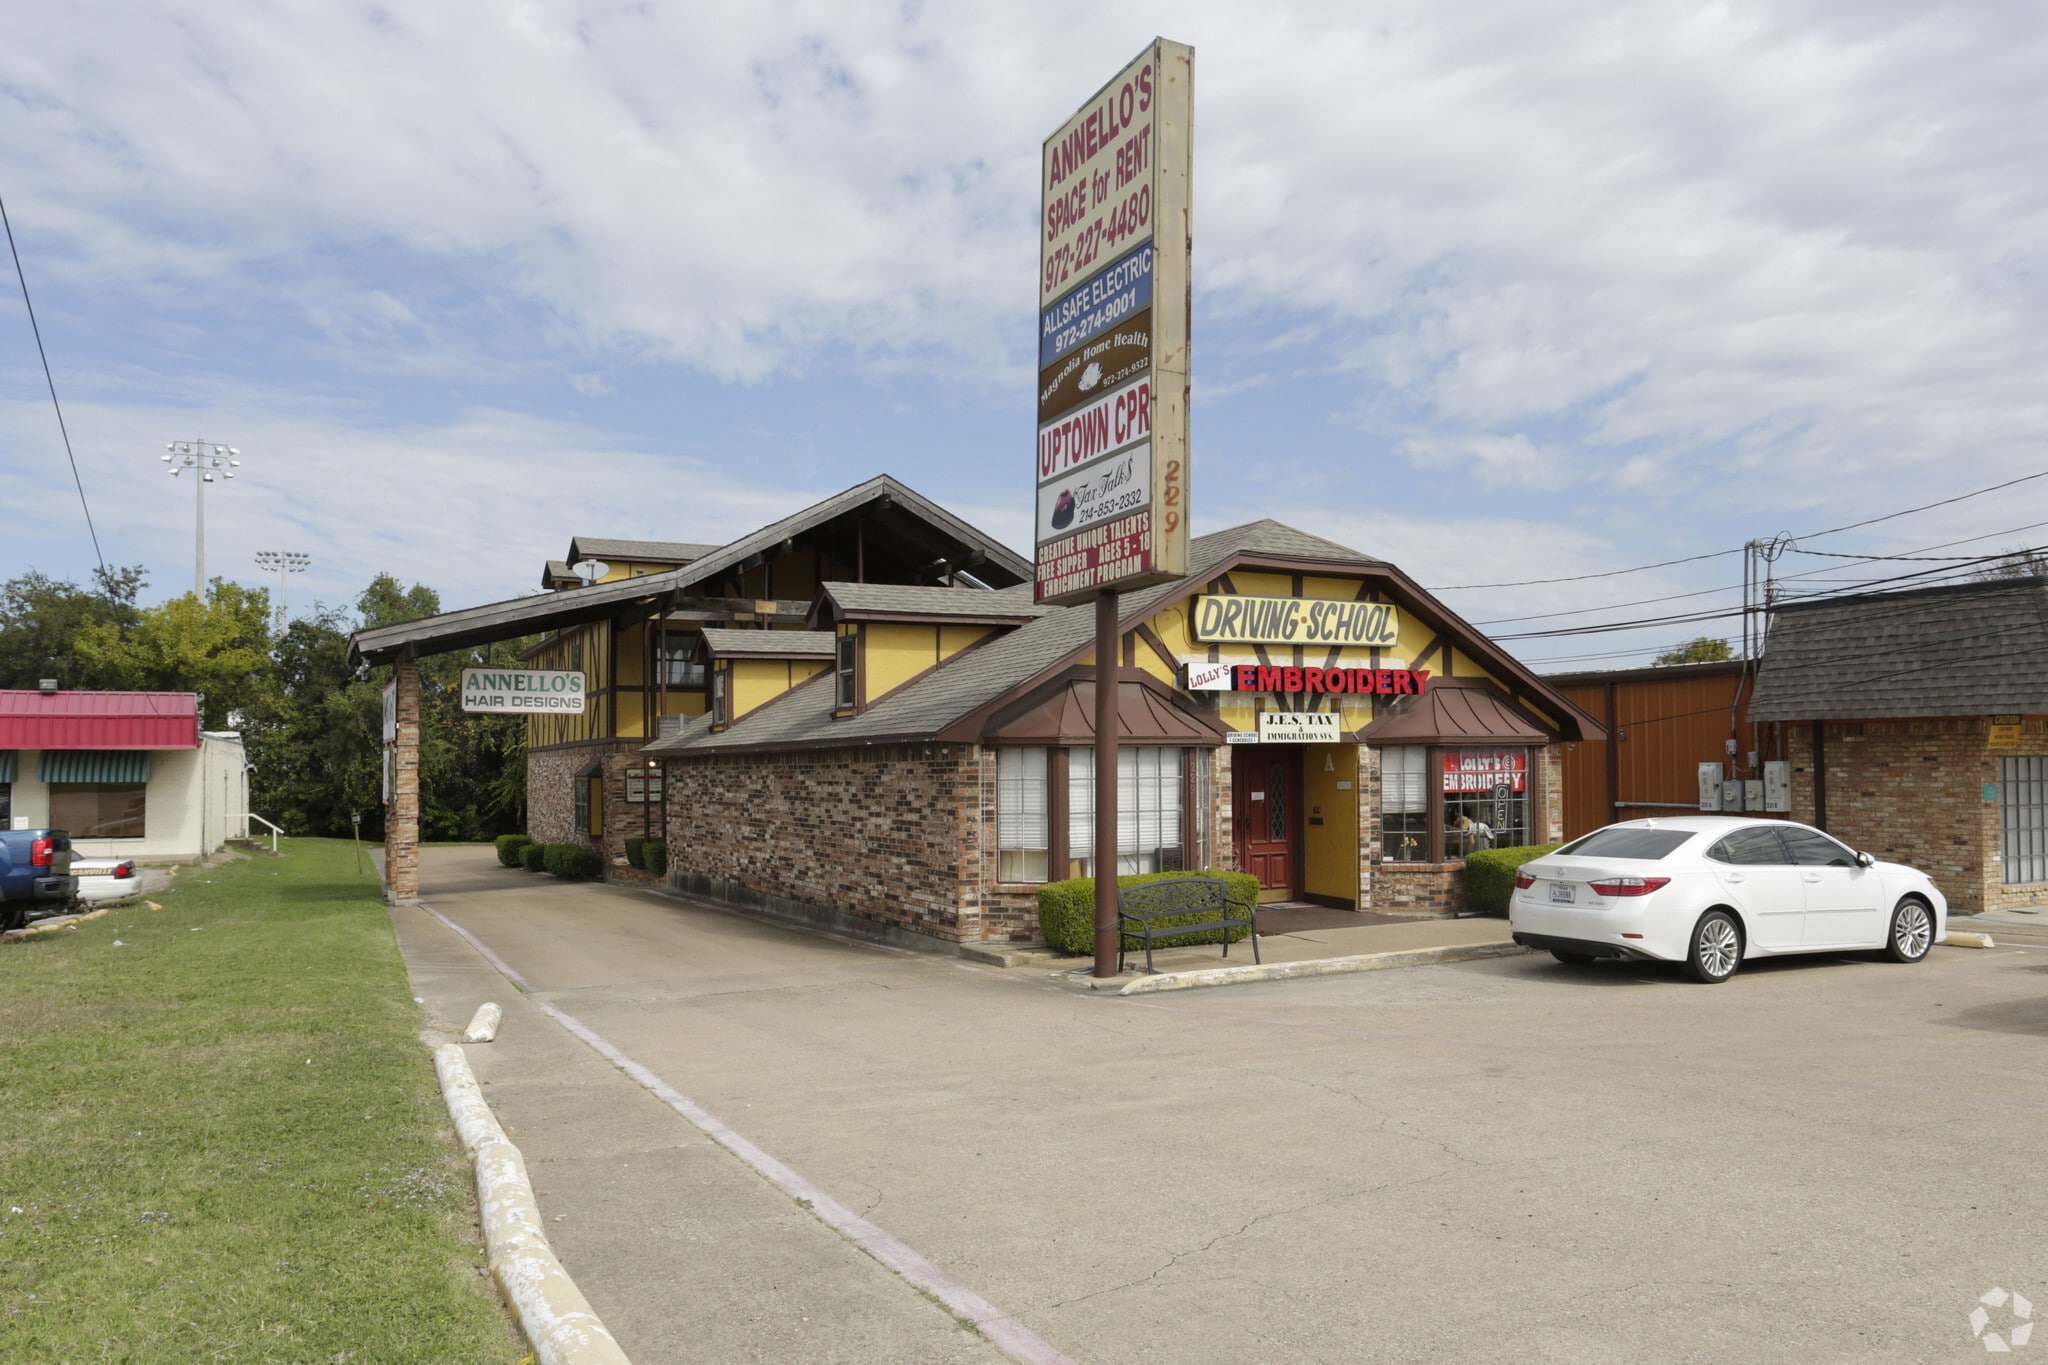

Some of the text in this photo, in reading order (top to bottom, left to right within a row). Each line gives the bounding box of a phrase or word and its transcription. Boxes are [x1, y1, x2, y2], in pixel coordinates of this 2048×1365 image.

[1049, 65, 1152, 191] ANNELLO'S
[1048, 123, 1150, 242] SPACE for RENT
[1046, 183, 1149, 293] 972-227-4480
[1043, 248, 1151, 337] ALLSAFE ELECTRIC
[1055, 288, 1136, 353] 972-274-9001
[1040, 331, 1148, 405] Magnolia Home Health
[1041, 383, 1150, 477] UPTOWN CPR
[1079, 489, 1142, 524] 214-853-2332
[1037, 561, 1055, 582] FREE
[1057, 552, 1087, 576] SUPPER
[1099, 541, 1121, 564] AGES
[1124, 538, 1130, 557] 5
[1139, 531, 1150, 552] 18
[1038, 511, 1149, 565] CREATIVE UNIQUE TALENTS
[1044, 554, 1141, 598] ENRICHMENT PROGRAM
[1200, 599, 1396, 643] DRIVING SCHOOL
[465, 672, 581, 693] ANNELLO'S
[465, 695, 582, 708] HAIR DESIGNS
[1190, 664, 1430, 695] LOLLY'S EMBROIDERY
[1266, 715, 1333, 725] J.E.S. TAX
